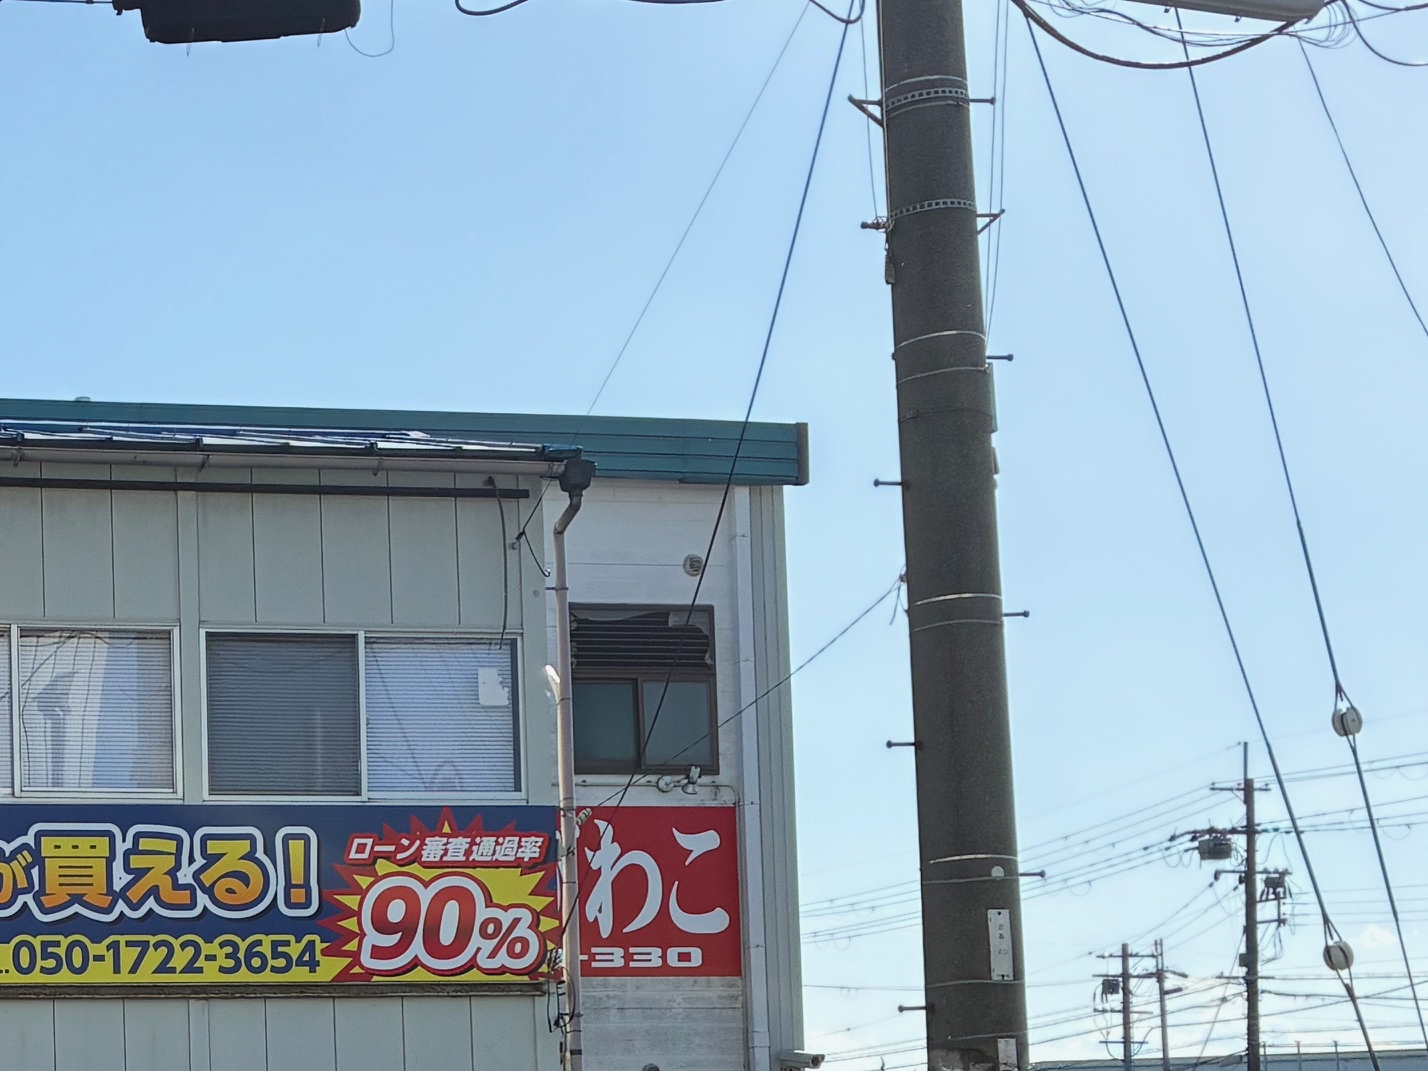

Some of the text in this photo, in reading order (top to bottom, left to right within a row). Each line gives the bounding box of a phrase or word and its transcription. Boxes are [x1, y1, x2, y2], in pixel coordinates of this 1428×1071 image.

[348, 834, 544, 863] ローン審査通過率
[556, 819, 730, 938] わこ
[367, 880, 537, 965] 90%
